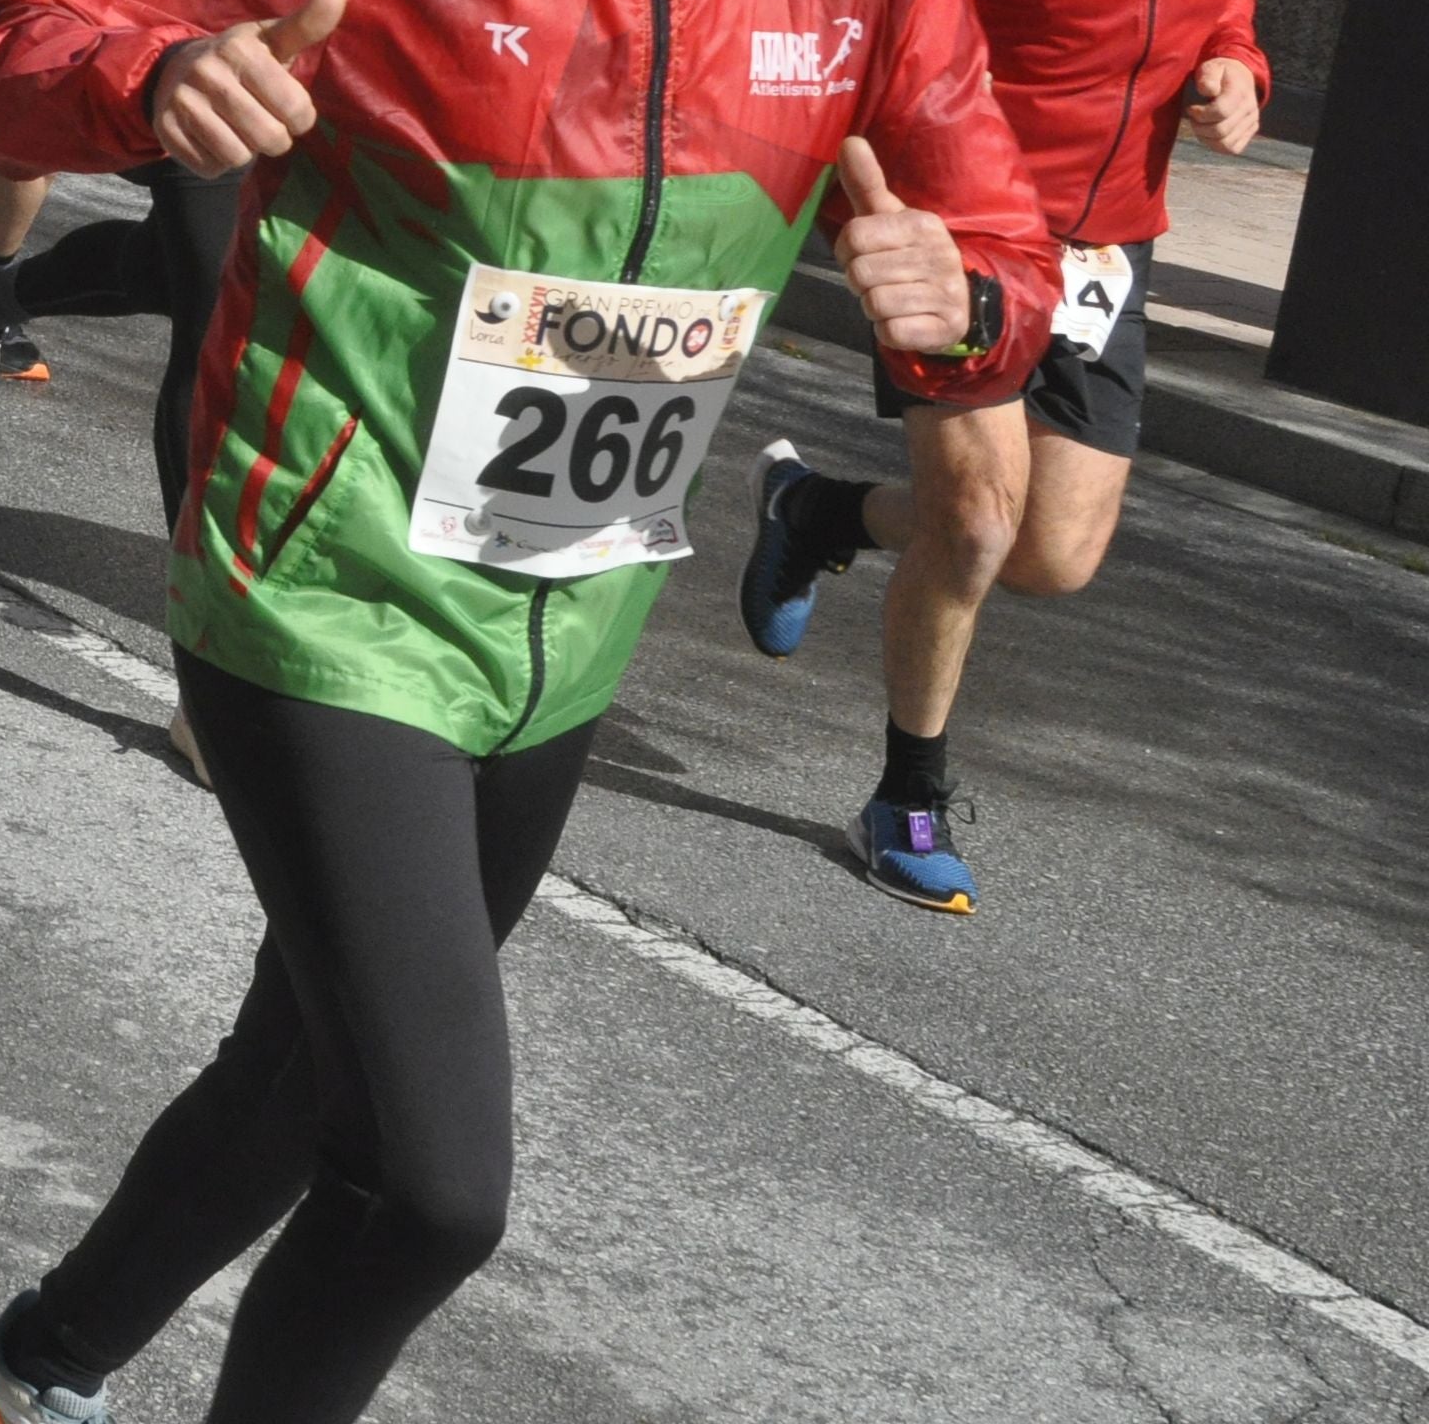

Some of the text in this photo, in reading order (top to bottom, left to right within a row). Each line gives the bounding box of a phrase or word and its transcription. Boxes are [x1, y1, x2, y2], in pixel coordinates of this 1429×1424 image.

[749, 80, 821, 97] Atletismo
[544, 288, 610, 313] GRAN
[619, 295, 694, 320] PREMIO
[534, 304, 713, 359] FONDO
[475, 386, 696, 504] 266
